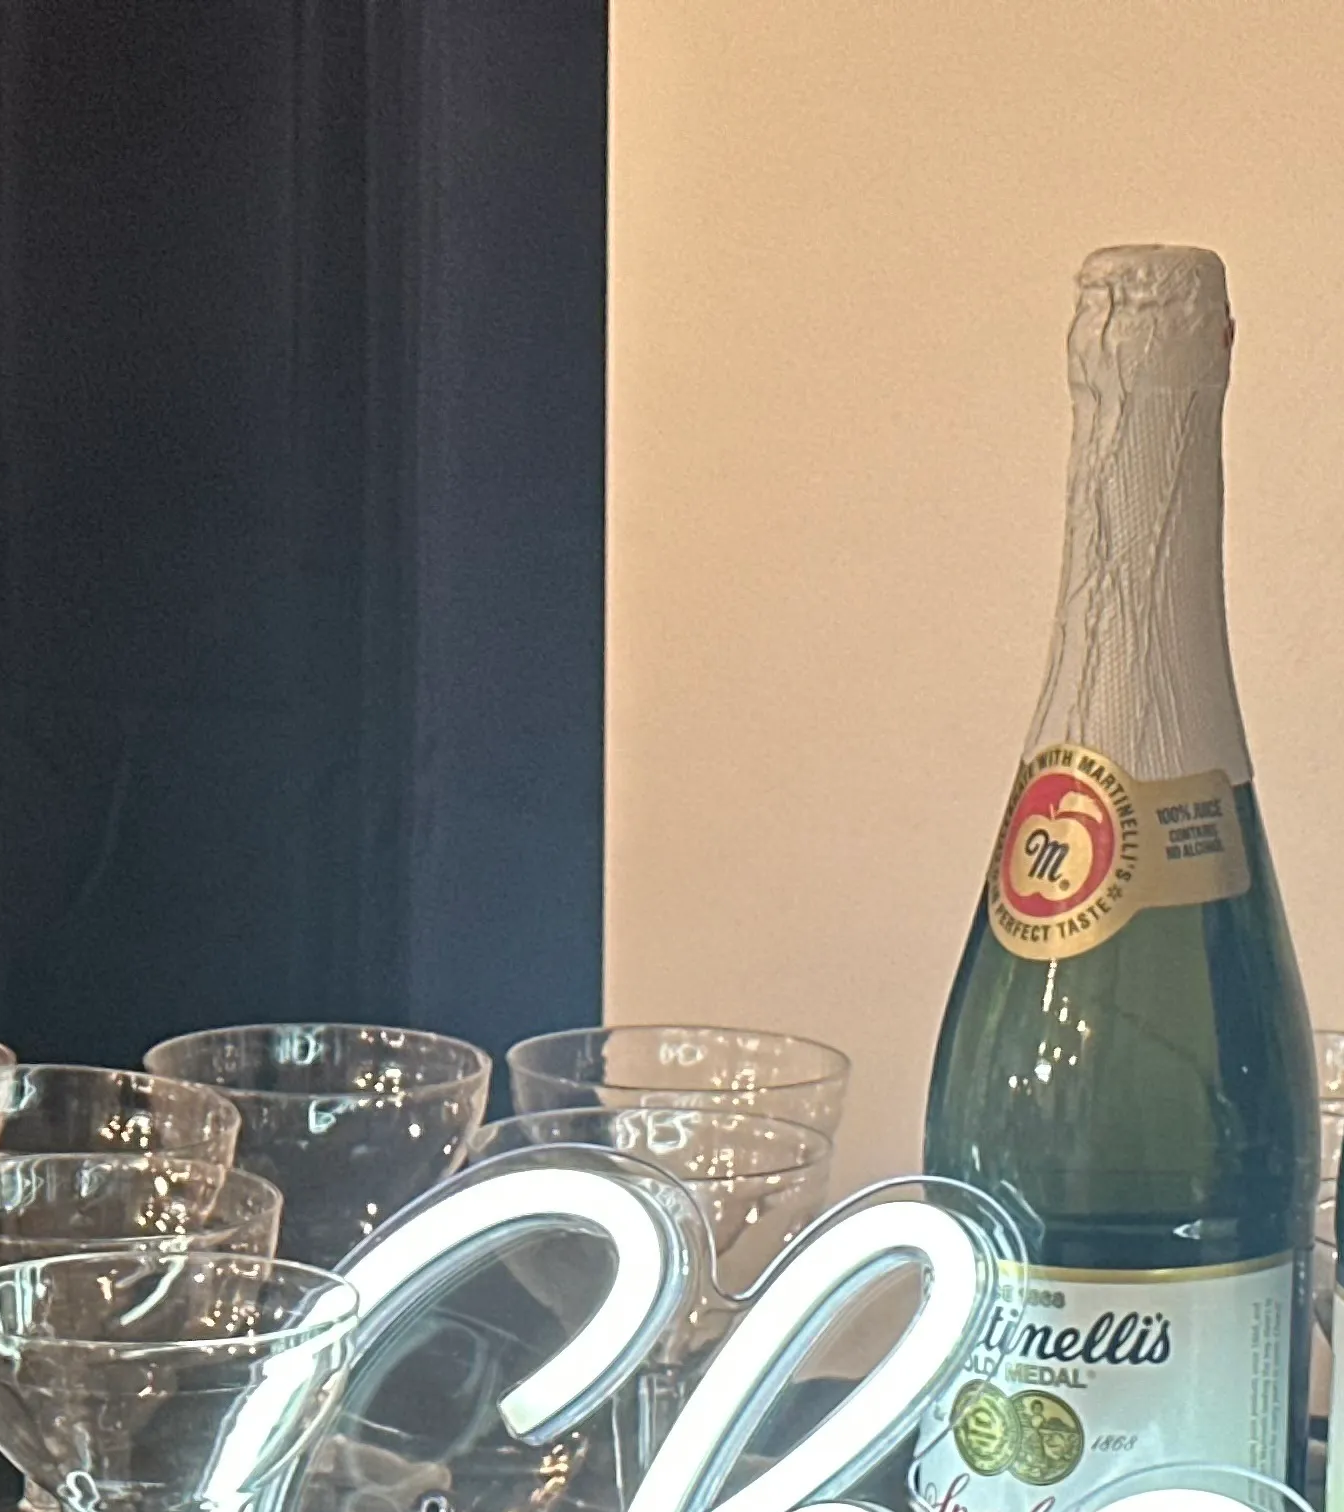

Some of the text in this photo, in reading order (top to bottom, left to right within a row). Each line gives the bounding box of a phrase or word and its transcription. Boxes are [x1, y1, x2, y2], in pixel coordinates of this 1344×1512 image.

[1078, 755, 1139, 882] MARTINELLI'S
[1058, 899, 1112, 938] TASTE
[1091, 1434, 1138, 1452] 1868
